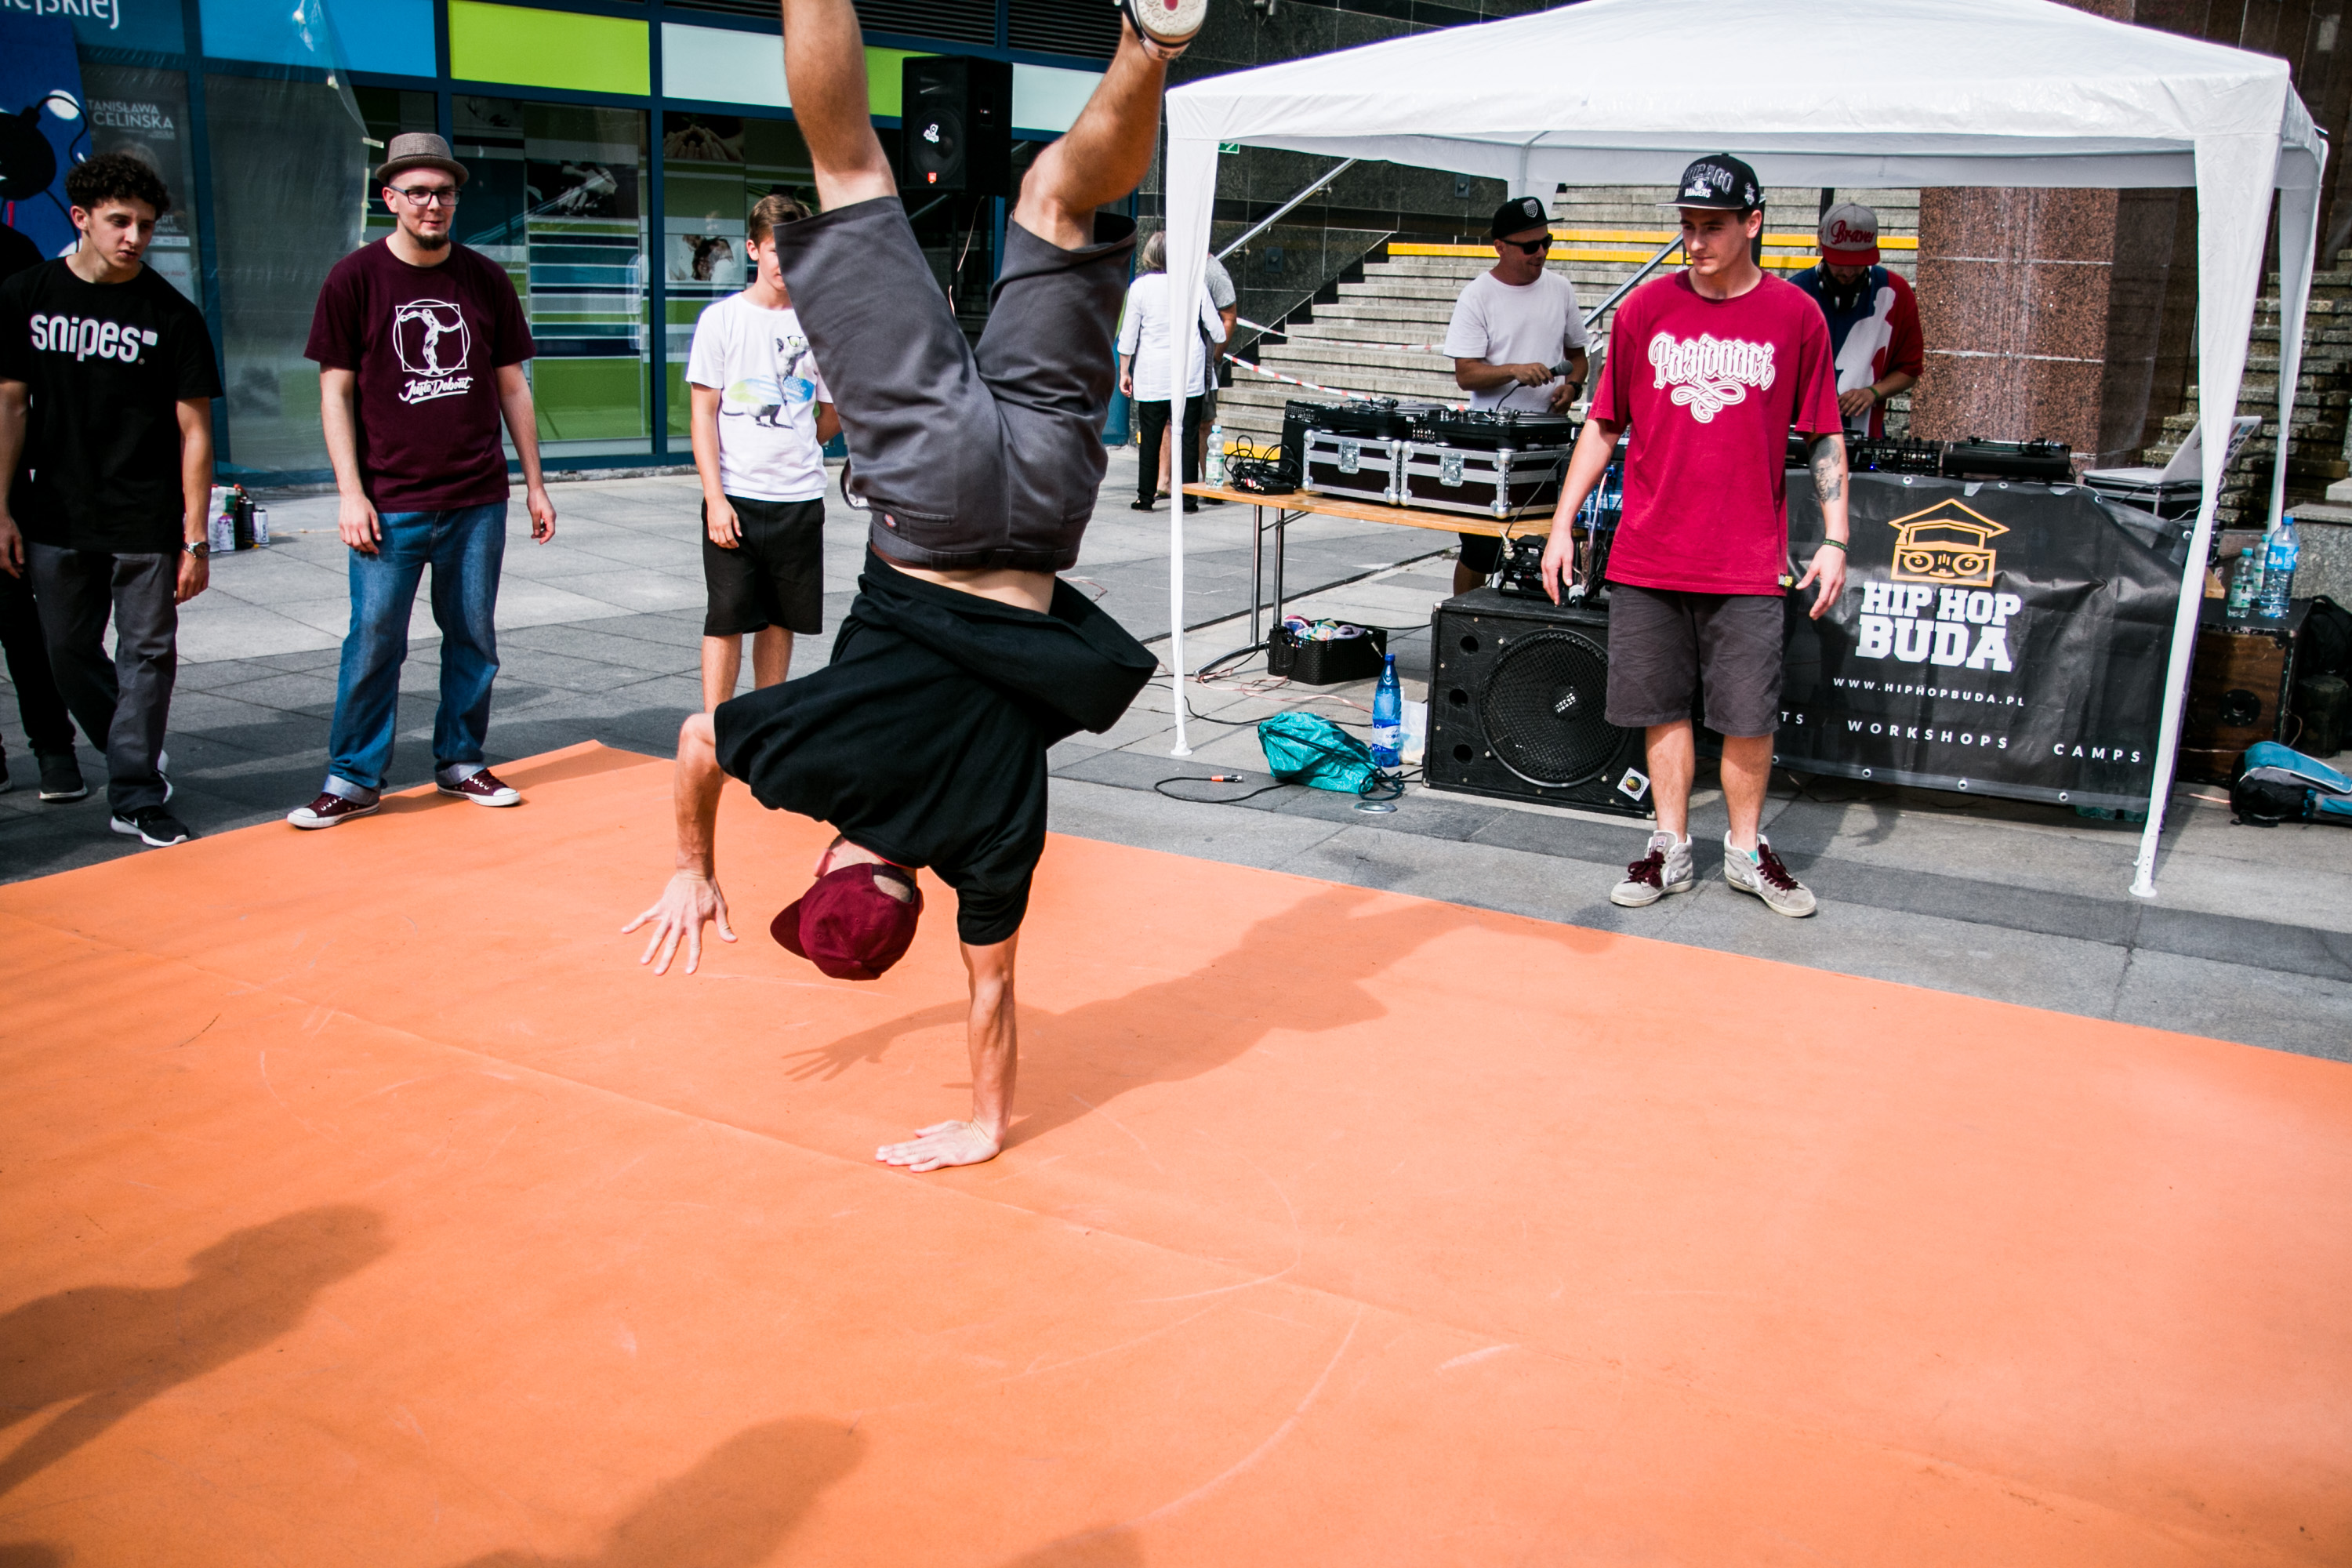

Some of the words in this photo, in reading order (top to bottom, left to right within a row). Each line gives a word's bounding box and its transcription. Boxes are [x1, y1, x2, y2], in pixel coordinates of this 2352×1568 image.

[93, 111, 174, 129] CELIŃSKA
[1684, 187, 1712, 198] RANGERS
[30, 314, 142, 362] snipes
[398, 379, 432, 402] Juste
[430, 376, 474, 396] Debout
[1860, 581, 1933, 618] HIP
[1936, 587, 2022, 626] HOP
[1855, 614, 2013, 673] BUDA
[1833, 677, 2024, 706] WWW.HIPHOPBUDA.PL
[1847, 720, 2007, 750] WORKSHOPS
[2053, 743, 2140, 763] CAMPS
